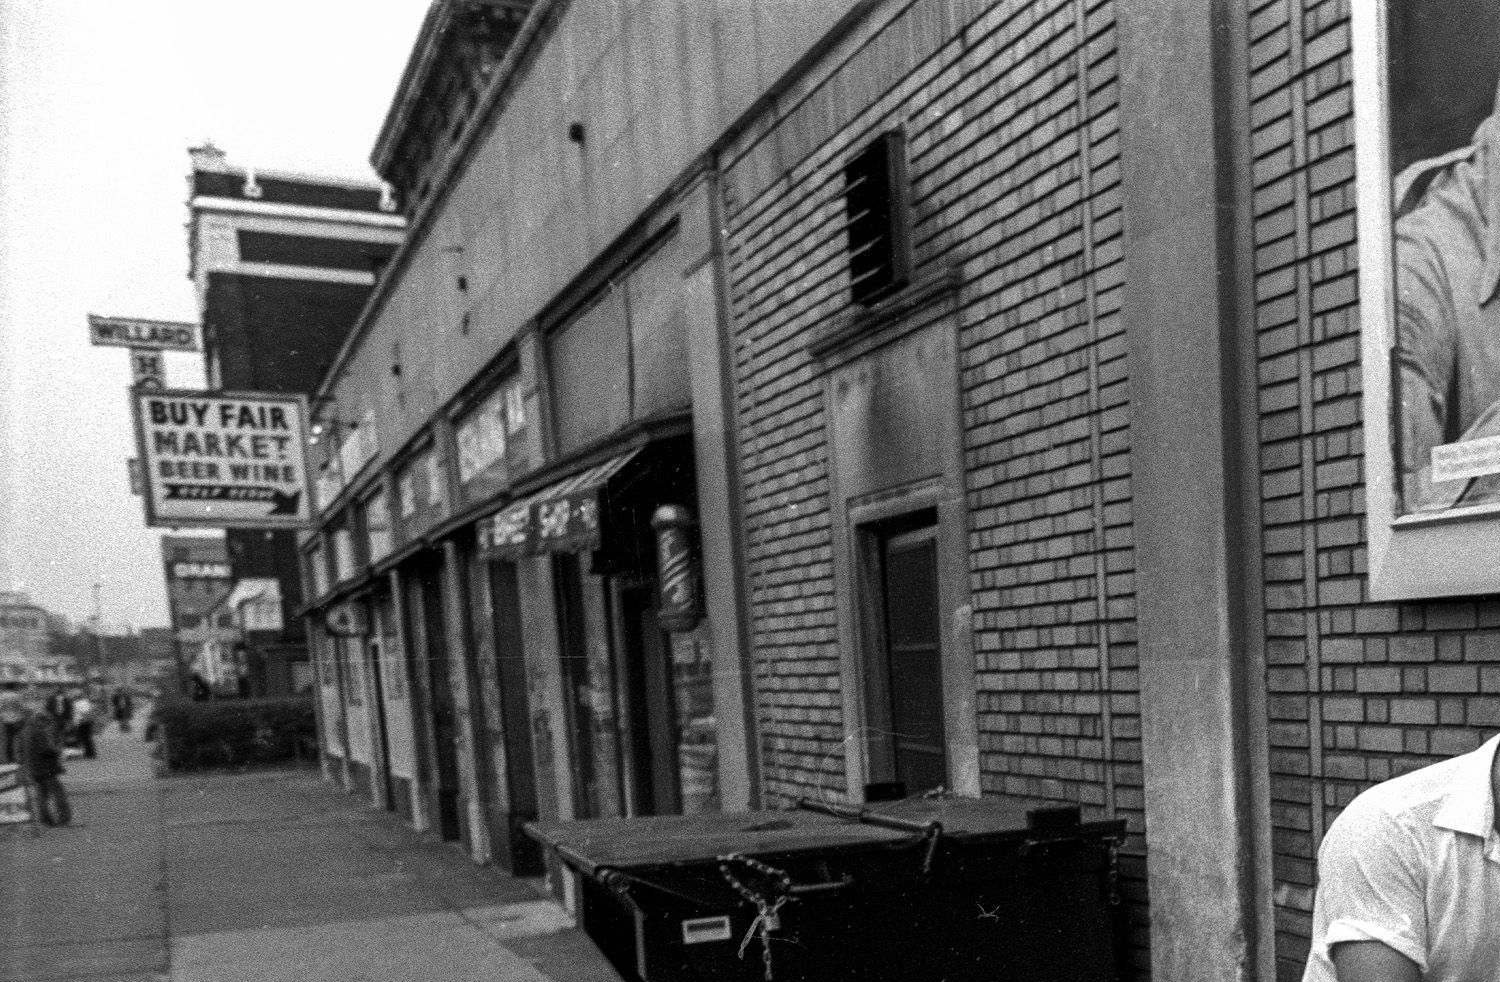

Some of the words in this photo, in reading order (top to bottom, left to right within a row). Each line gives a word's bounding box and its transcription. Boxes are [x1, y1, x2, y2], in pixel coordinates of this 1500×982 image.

[94, 323, 191, 344] WILLARD
[149, 400, 210, 427] BUY
[219, 403, 289, 430] FAIR
[153, 431, 291, 460] MARKET
[158, 460, 221, 480] BEER
[229, 463, 296, 484] WINE
